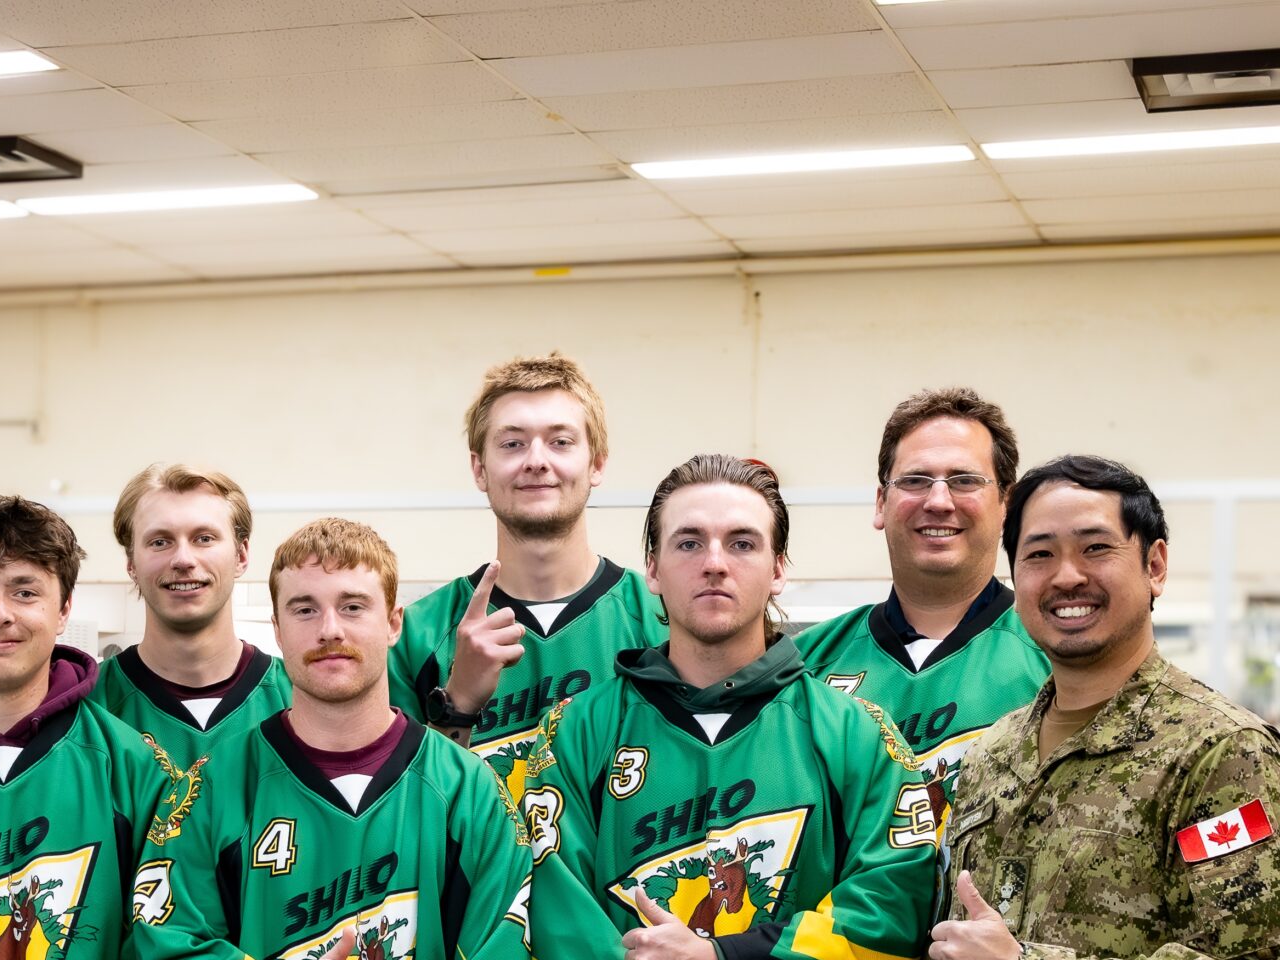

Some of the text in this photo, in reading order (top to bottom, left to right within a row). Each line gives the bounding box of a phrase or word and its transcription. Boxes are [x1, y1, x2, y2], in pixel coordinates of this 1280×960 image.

[472, 669, 591, 734] SHILO
[608, 743, 649, 800] 3
[251, 817, 298, 878] 4
[631, 778, 756, 858] SHILO
[281, 851, 399, 939] SHILO
